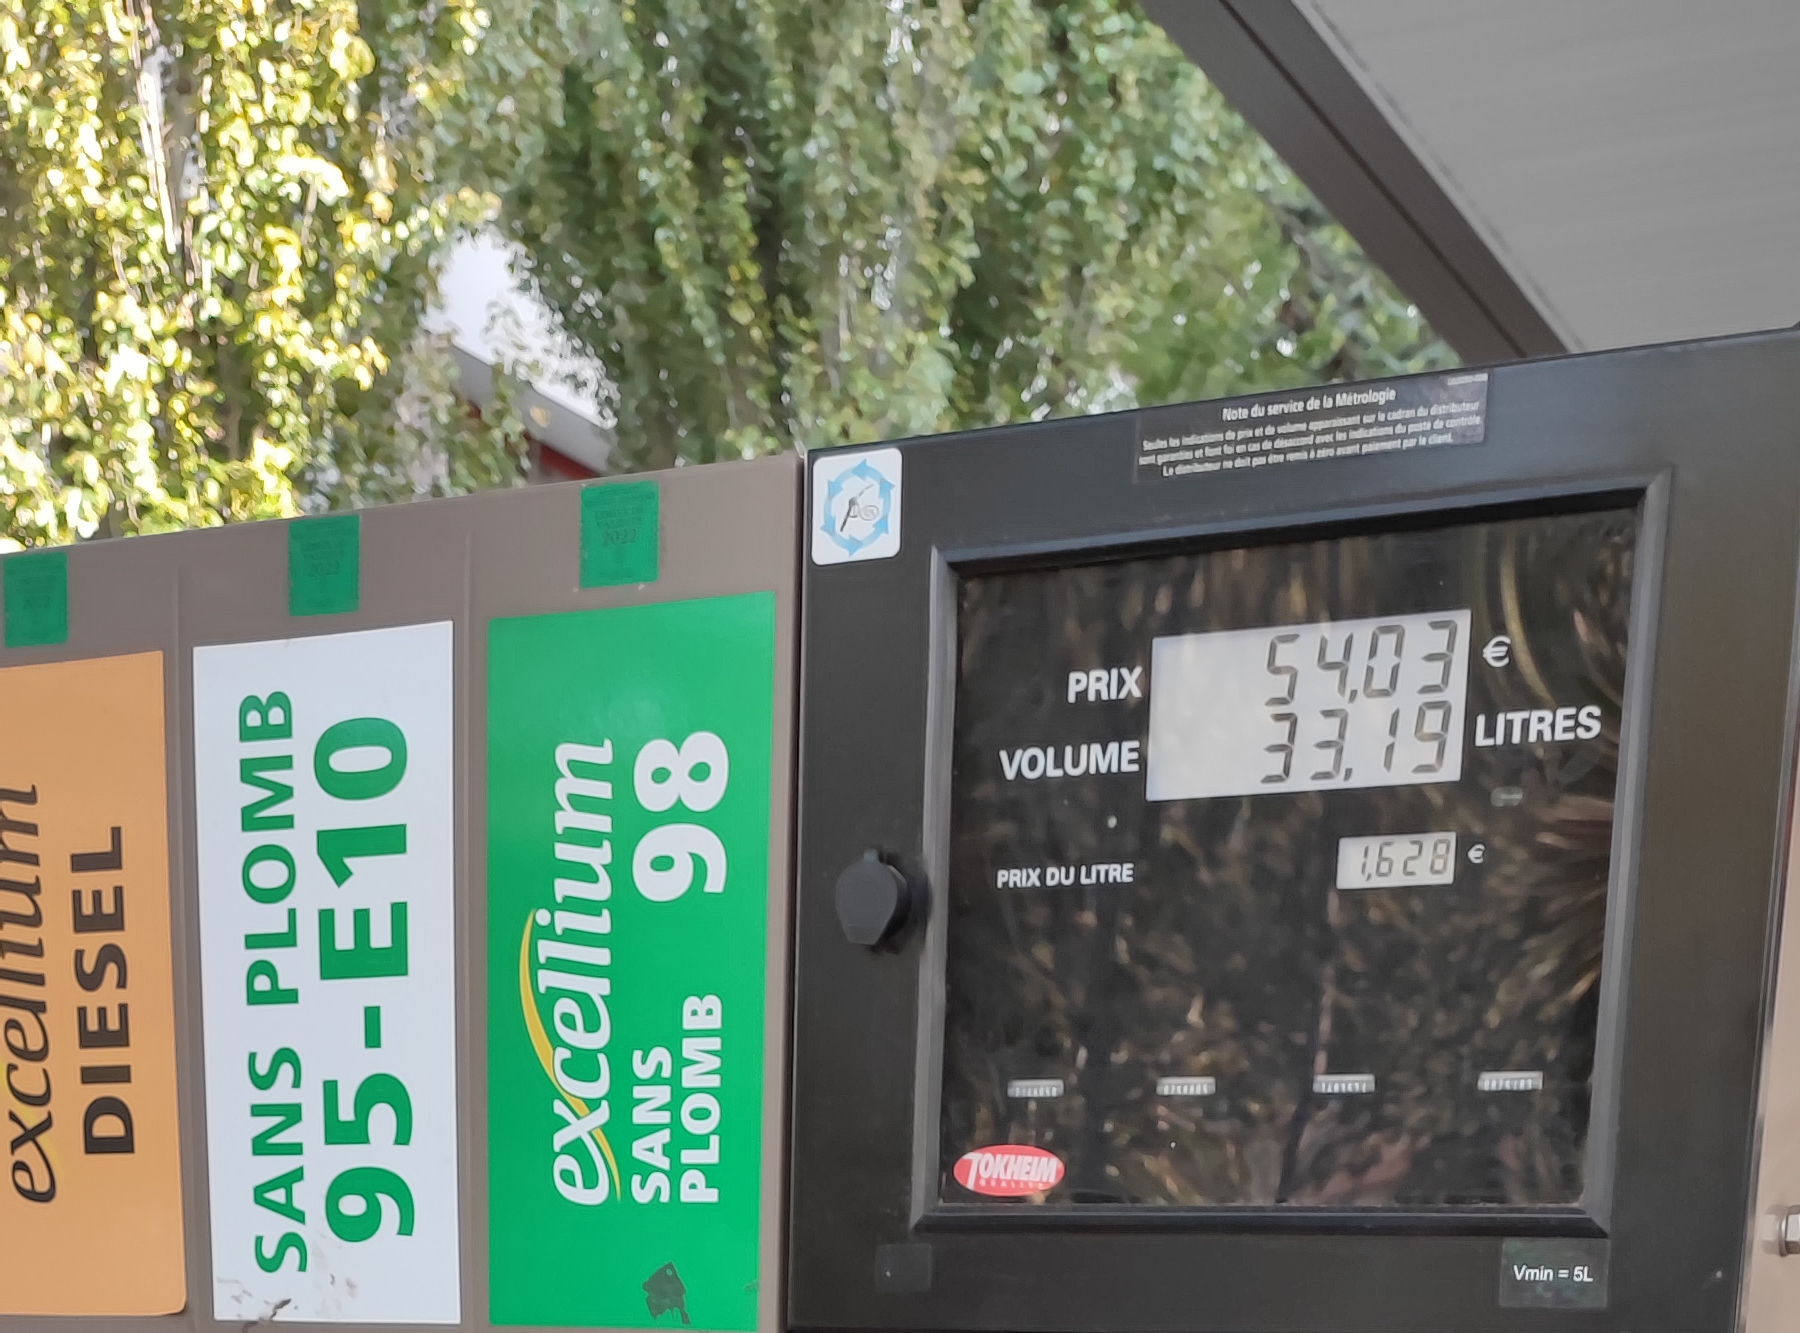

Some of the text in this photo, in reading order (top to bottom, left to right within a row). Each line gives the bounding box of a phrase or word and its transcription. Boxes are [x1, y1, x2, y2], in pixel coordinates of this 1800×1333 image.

[1222, 387, 1396, 421] Note du service de la Métrologie
[999, 700, 1602, 784] VOLUME 33,19 LITRES
[1067, 620, 1511, 707] PRIX 54,03 €
[633, 731, 730, 903] 98
[997, 839, 1486, 889] PRIX DU LITRE 1,628 €
[70, 826, 136, 1155] DIESEL
[238, 690, 308, 1274] SANS PLOMB
[314, 716, 414, 1244] 95-E10
[535, 737, 614, 1205] excellium
[631, 1046, 672, 1204] SANS
[680, 994, 723, 1204] PLOMB
[962, 1152, 1059, 1190] TOKHEIM
[1513, 1265, 1594, 1282] Vmin = 5L
